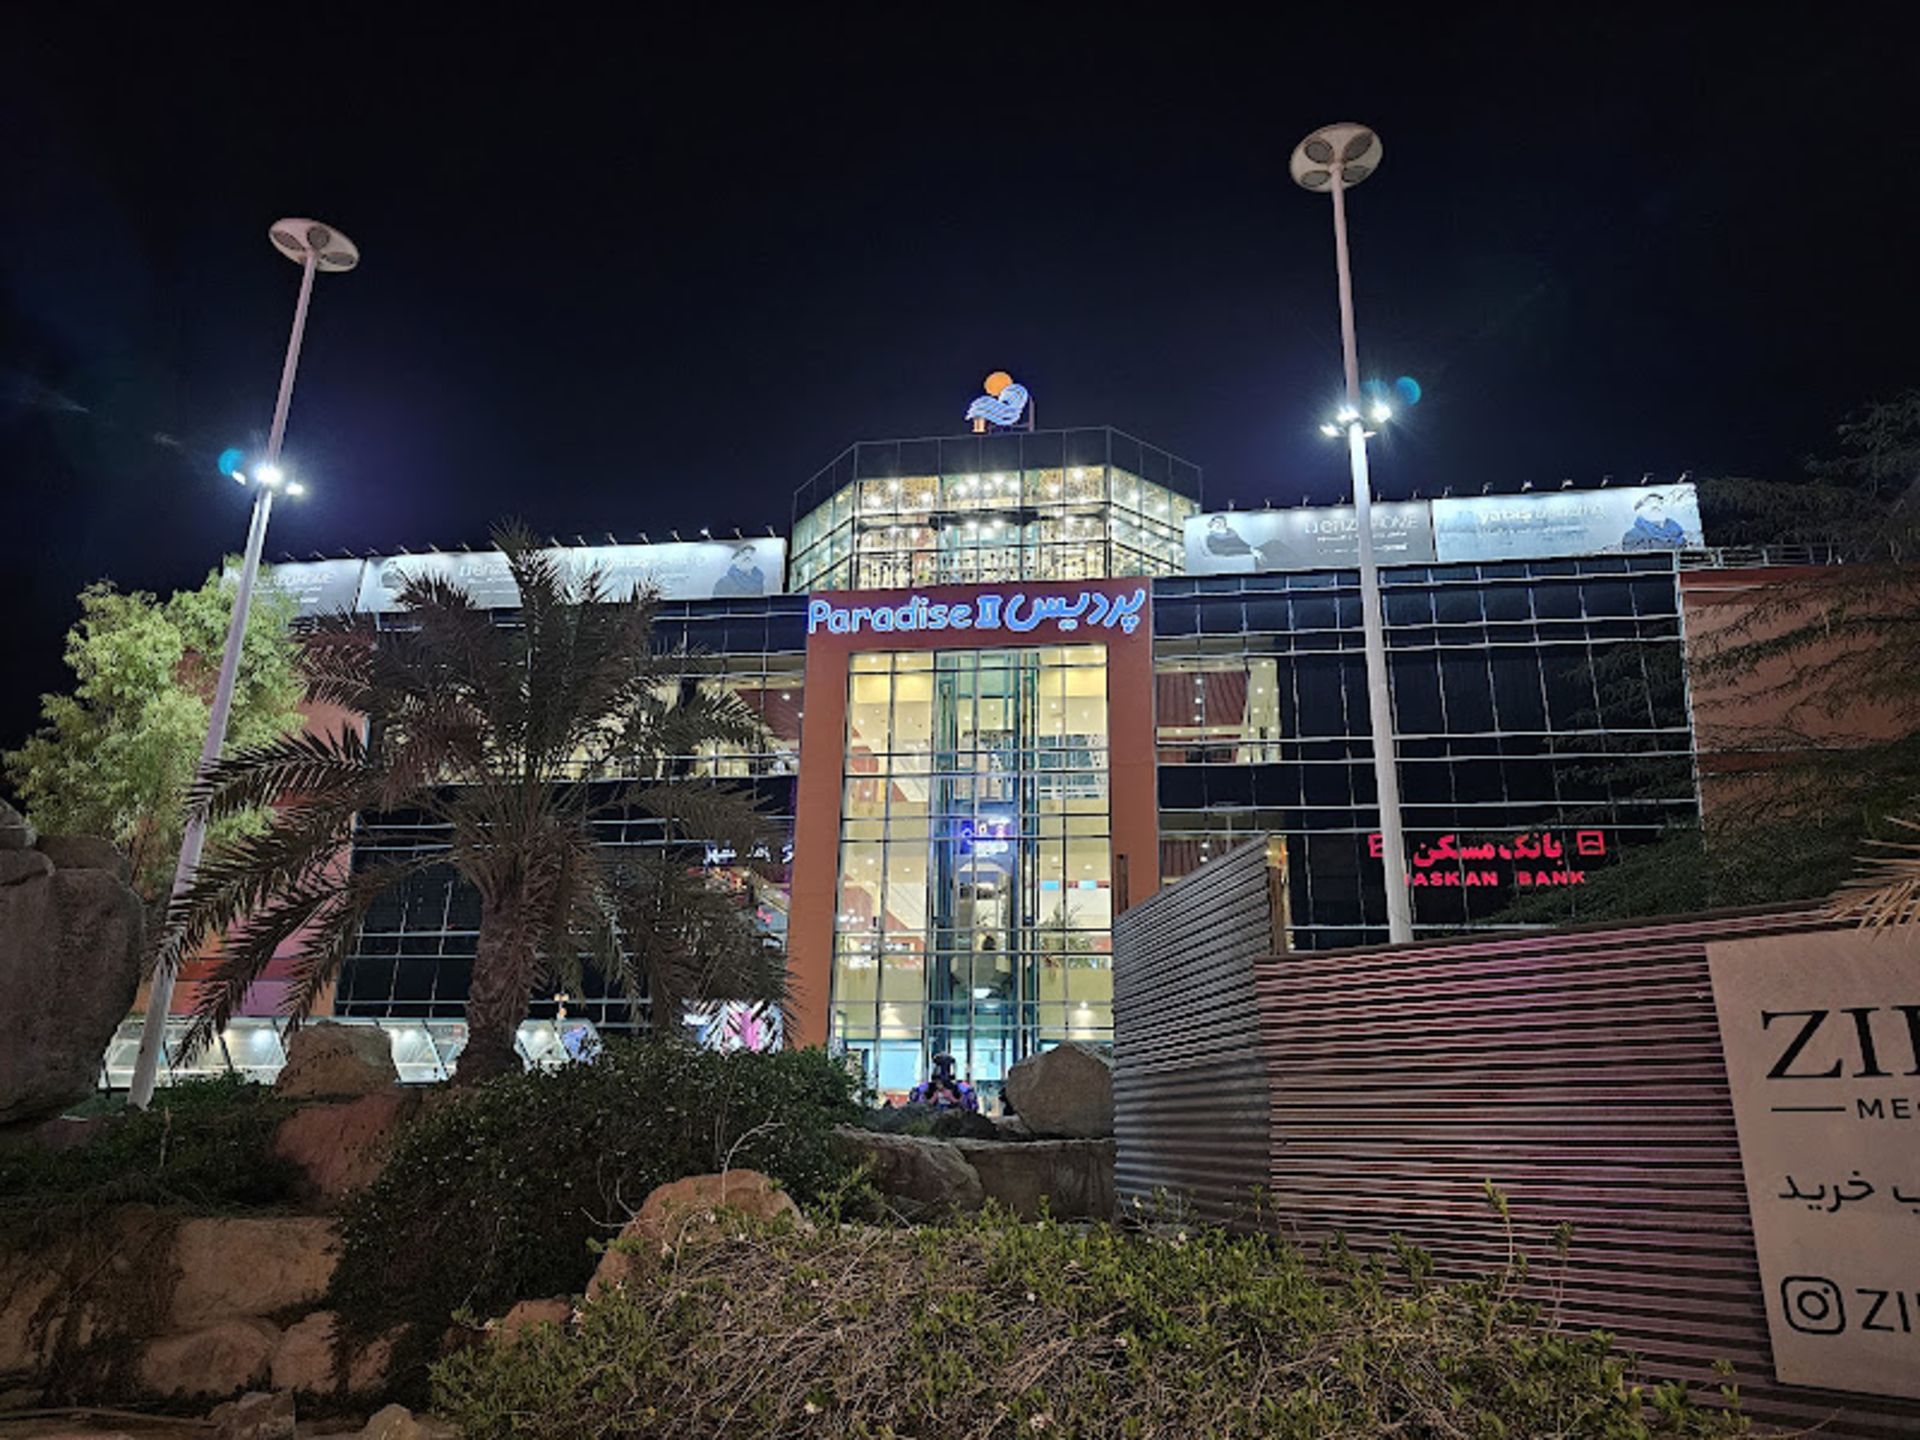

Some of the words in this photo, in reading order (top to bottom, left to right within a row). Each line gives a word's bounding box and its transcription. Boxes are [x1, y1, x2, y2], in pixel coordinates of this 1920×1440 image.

[808, 595, 972, 634] Paradise
[1005, 588, 1146, 634] پردیس
[1413, 834, 1497, 868] مسکن
[1500, 832, 1564, 866] بانک
[1404, 871, 1499, 887] ASKAN
[1517, 870, 1586, 886] BANK
[1856, 1098, 1920, 1120] ME
[1778, 1170, 1875, 1213] خرید
[1856, 1287, 1920, 1333] ZI
